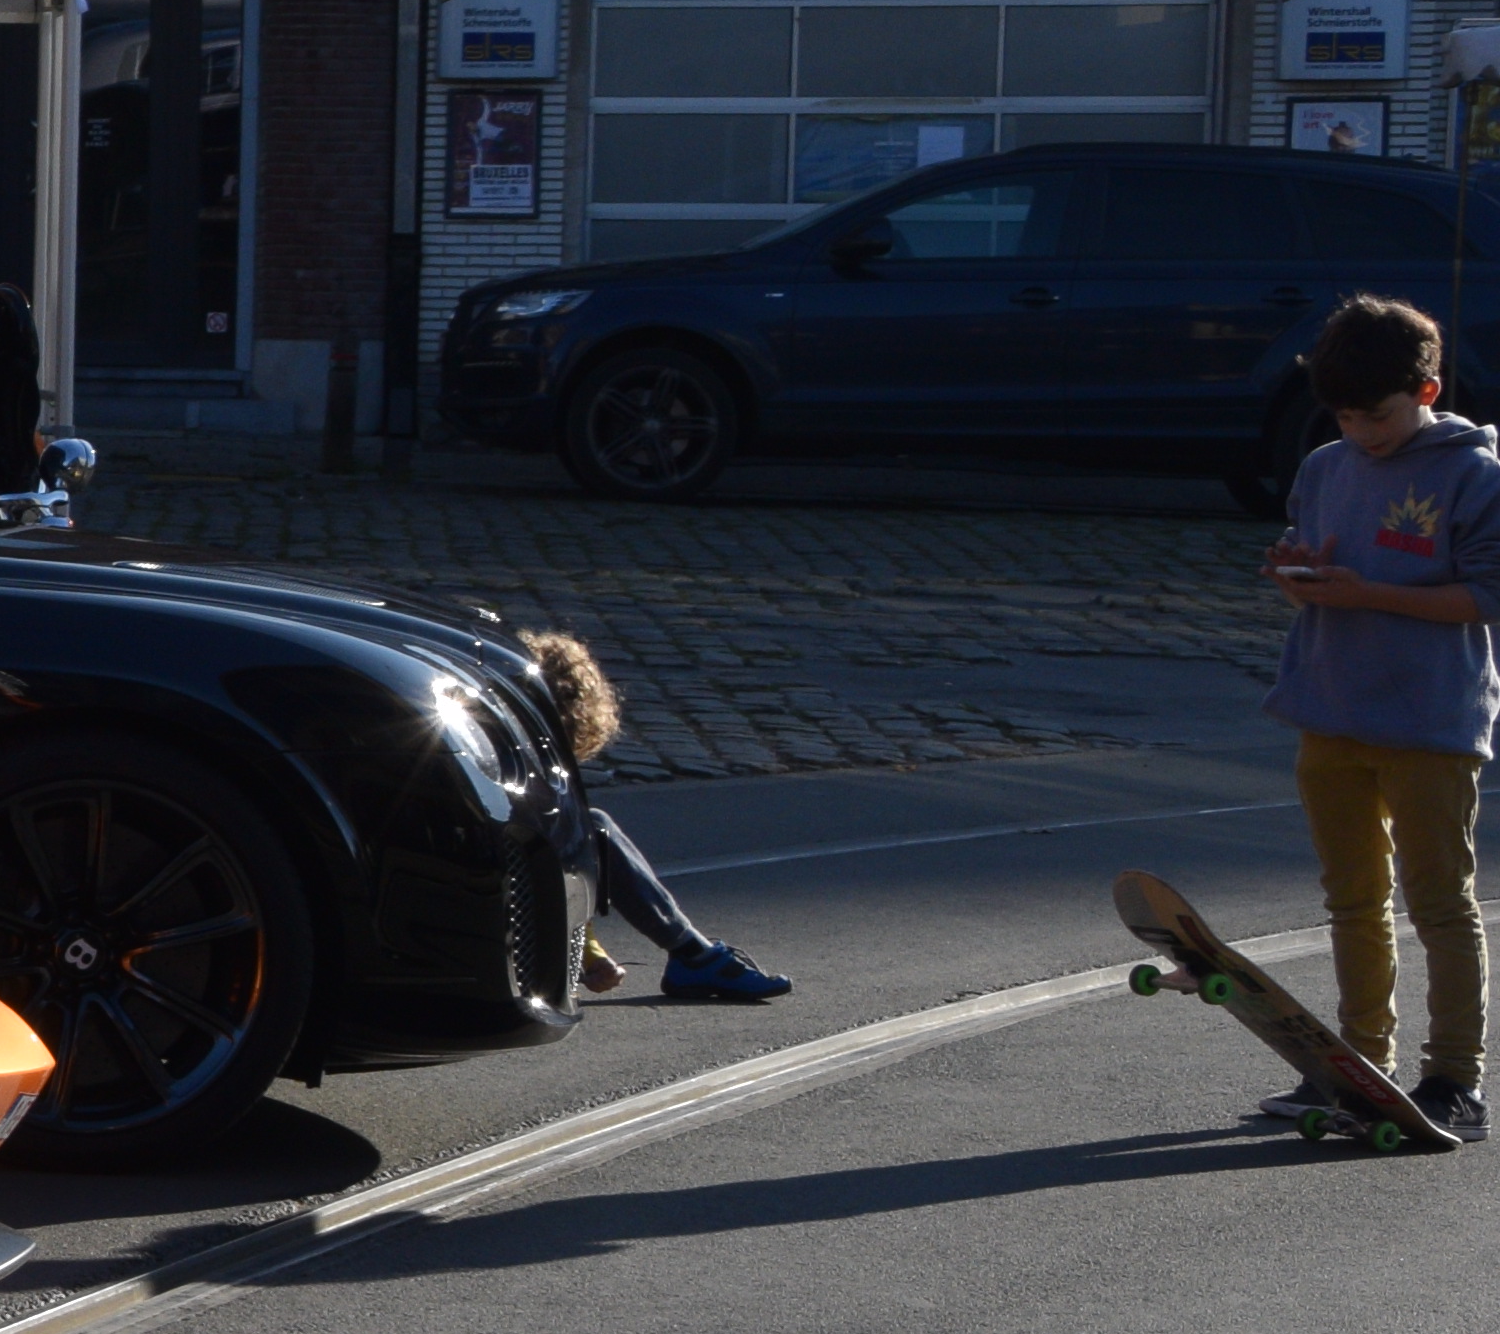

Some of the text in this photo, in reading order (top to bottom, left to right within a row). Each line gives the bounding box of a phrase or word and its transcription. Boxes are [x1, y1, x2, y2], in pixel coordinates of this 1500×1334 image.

[1307, 7, 1372, 16] Wintershall
[1307, 17, 1383, 27] Schmierstoffe
[472, 166, 530, 179] BRUXELLES
